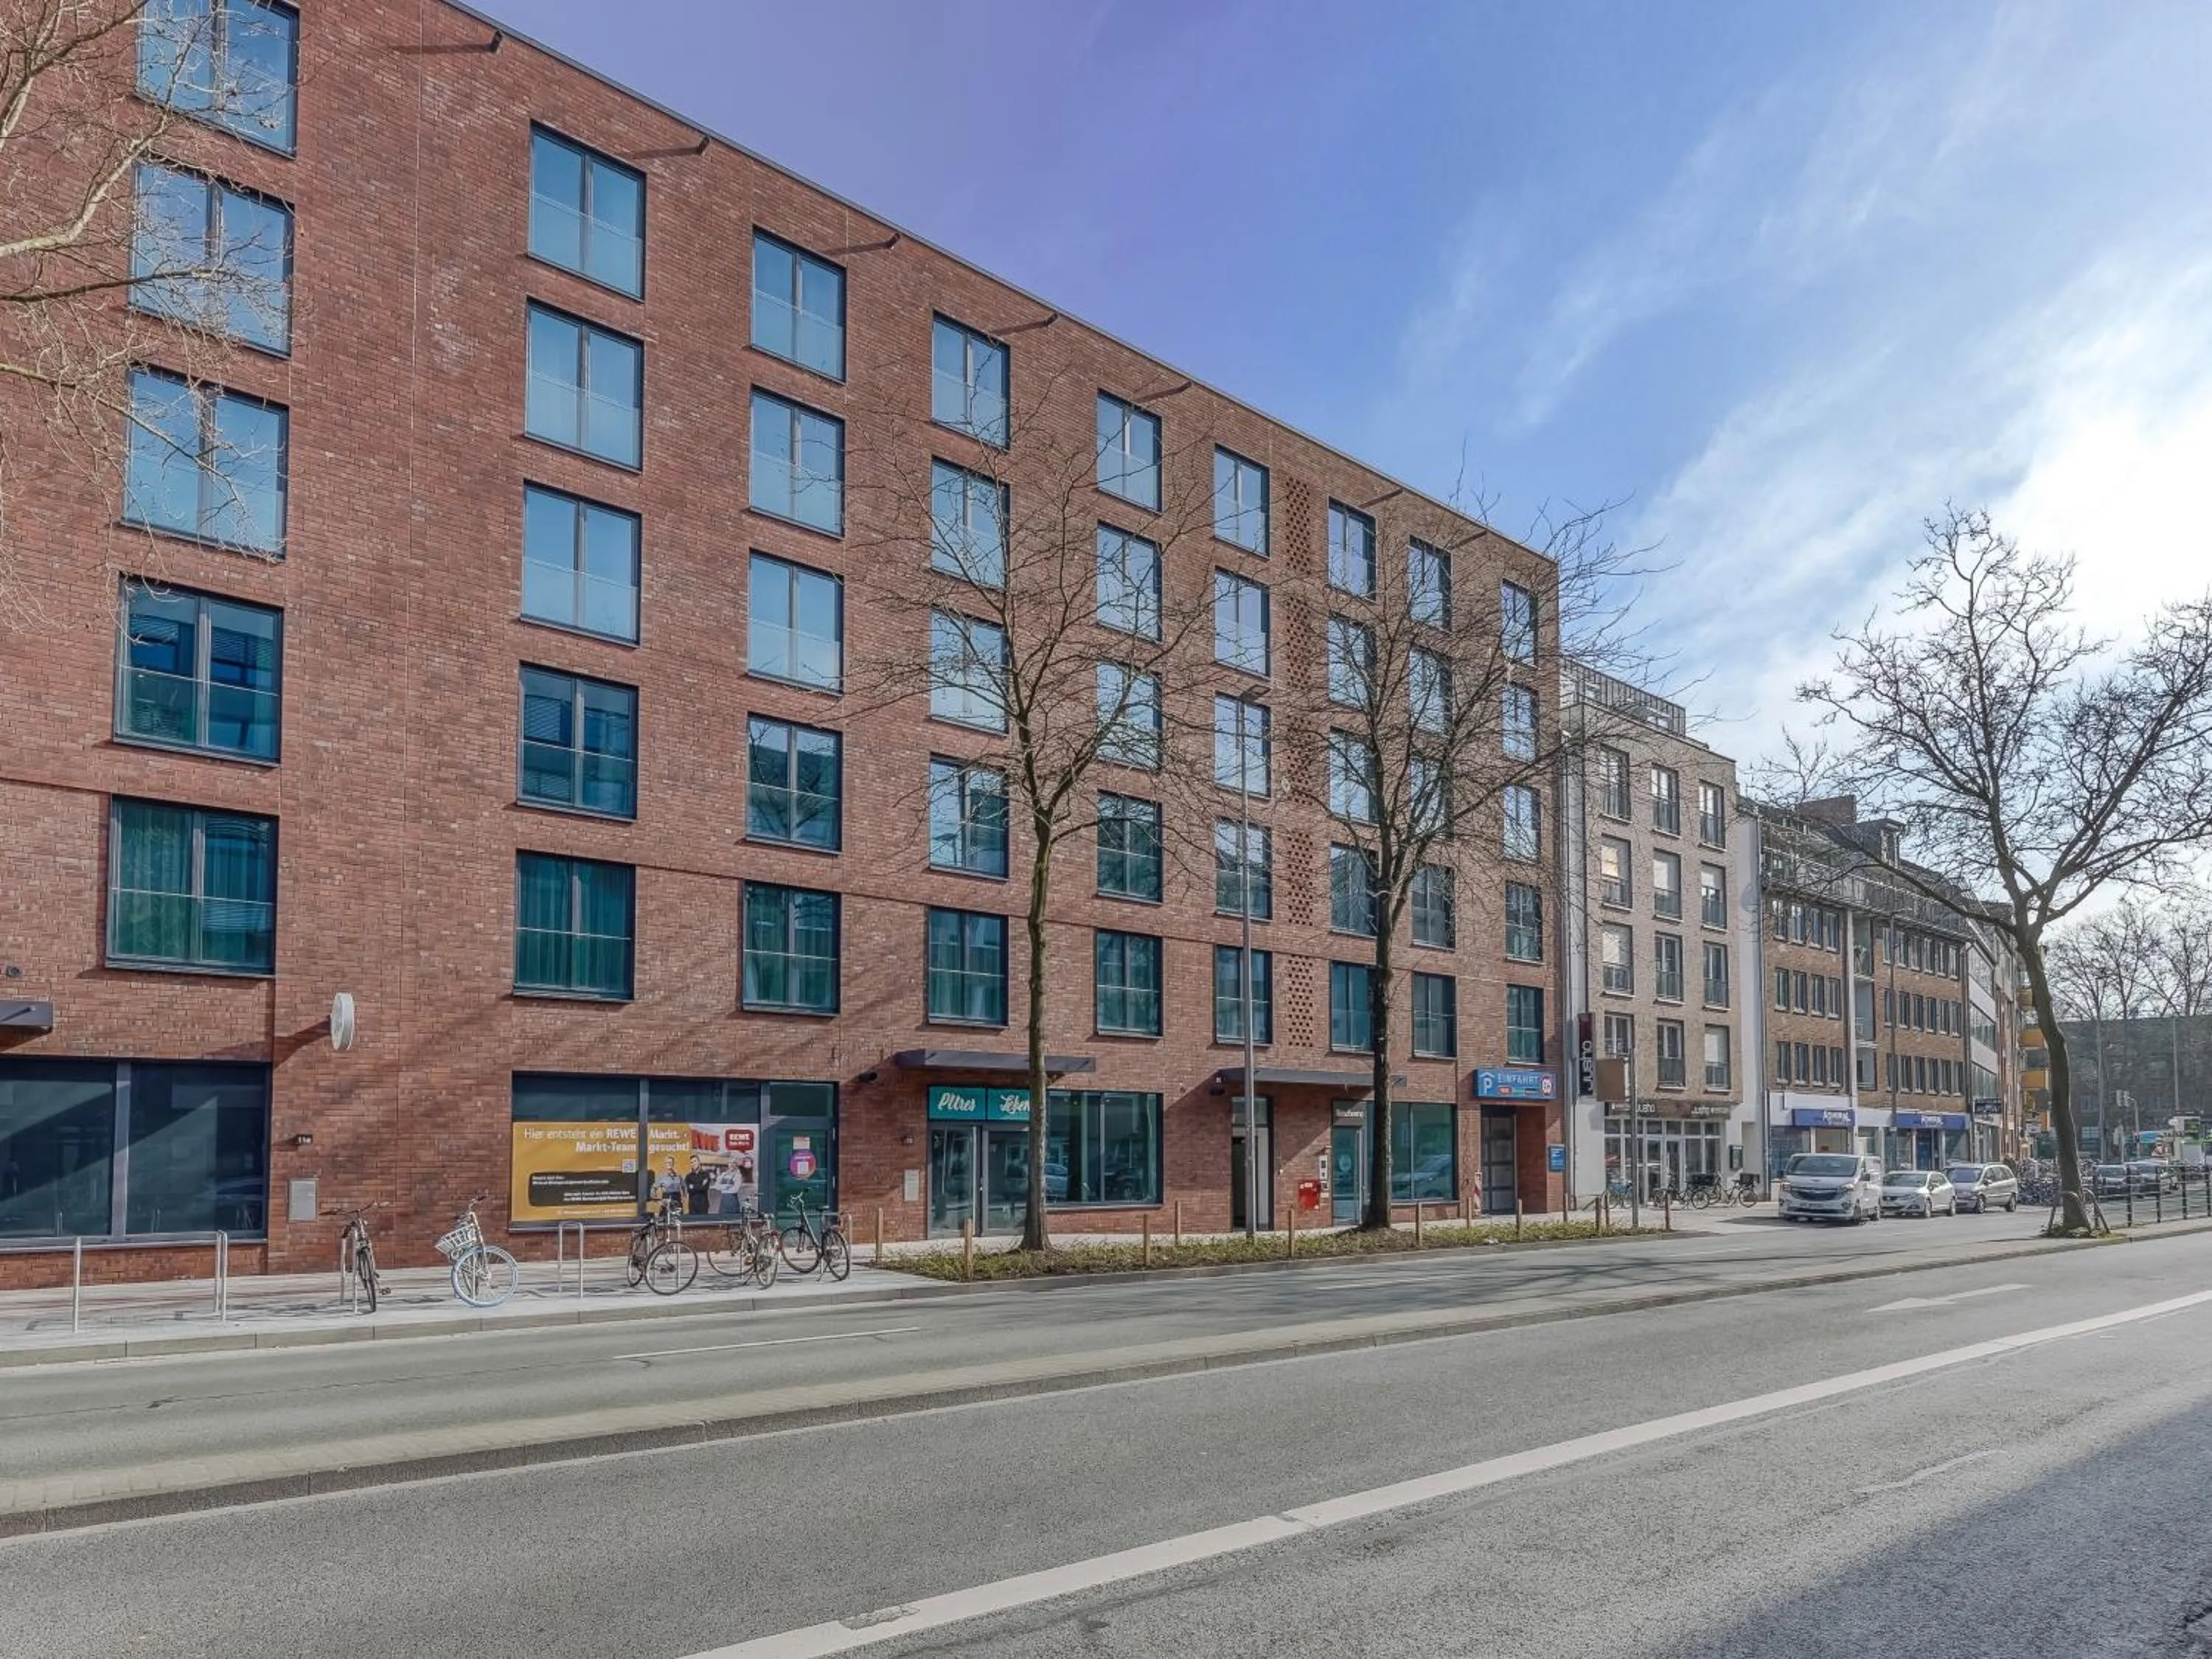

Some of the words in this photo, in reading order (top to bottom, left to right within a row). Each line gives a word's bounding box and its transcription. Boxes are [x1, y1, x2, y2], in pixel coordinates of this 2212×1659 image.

[1498, 1073, 1539, 1085] EINFAHRT
[607, 1127, 637, 1138] REWE
[648, 1142, 689, 1153] gesucht!
